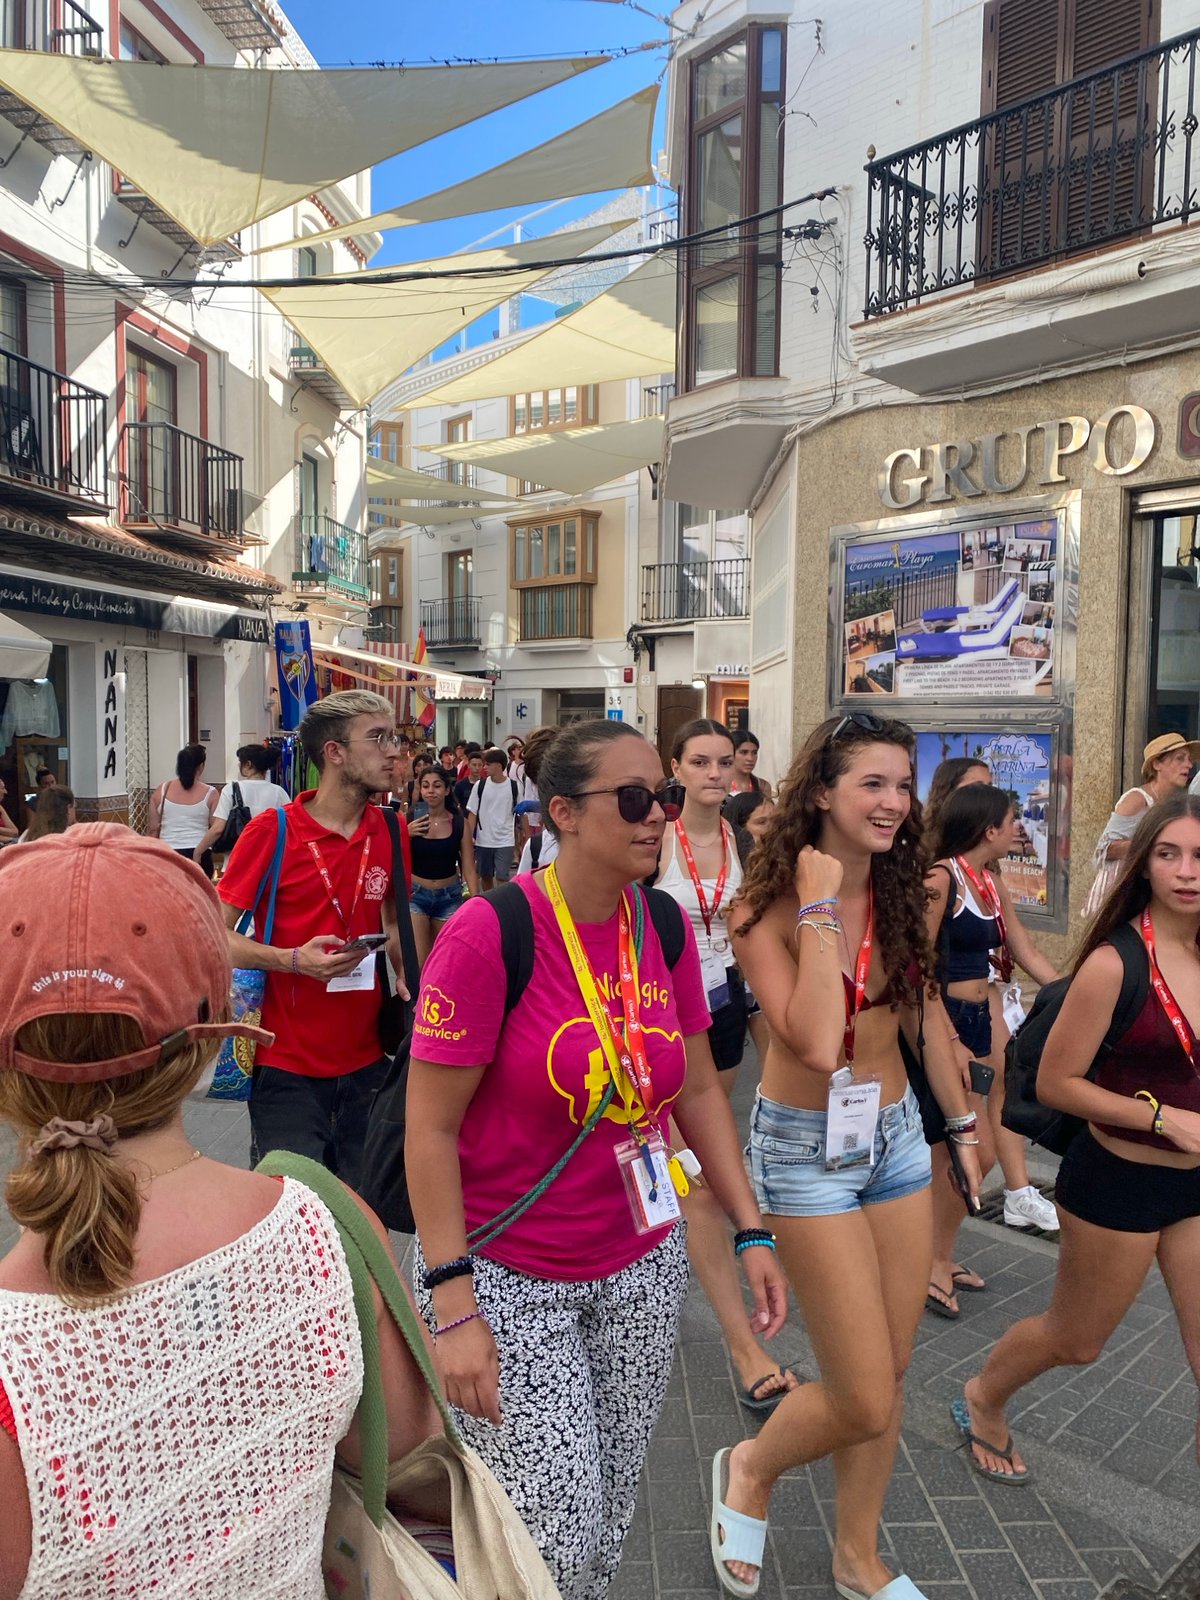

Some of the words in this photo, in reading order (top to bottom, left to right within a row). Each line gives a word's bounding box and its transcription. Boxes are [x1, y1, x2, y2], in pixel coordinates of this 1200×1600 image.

[878, 404, 1155, 509] GRUPO
[850, 559, 894, 571] Euromar
[900, 551, 934, 568] Playa
[31, 585, 60, 606] Moda
[62, 600, 70, 615] y
[238, 618, 265, 640] NANA
[103, 649, 118, 779] NANA
[991, 740, 1030, 757] PERLA
[991, 761, 1035, 777] MARINA
[1010, 866, 1021, 874] THE
[32, 974, 52, 992] this
[53, 971, 60, 981] is
[62, 969, 89, 981] your
[92, 968, 114, 983] sign
[423, 994, 440, 1024] ts
[661, 1183, 677, 1215] STAFF
